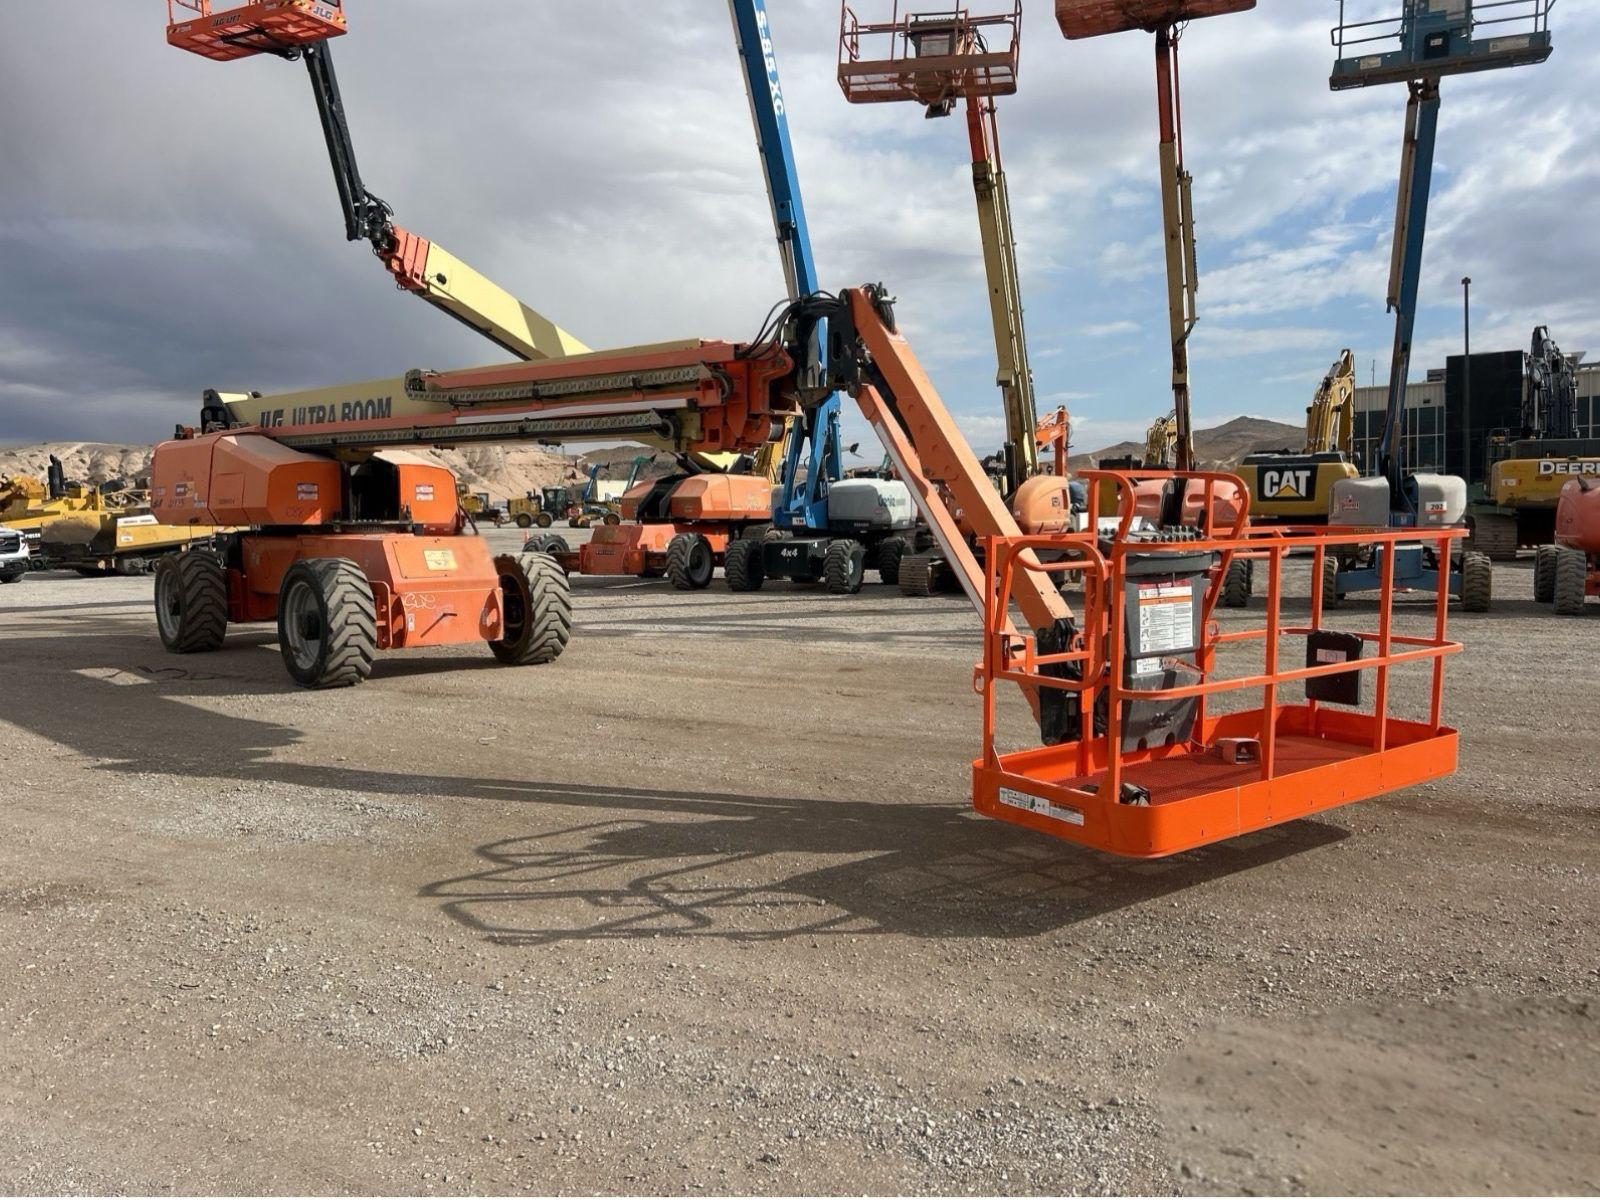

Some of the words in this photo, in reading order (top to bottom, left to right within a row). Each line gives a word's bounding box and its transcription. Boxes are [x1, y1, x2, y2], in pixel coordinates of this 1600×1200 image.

[313, 6, 334, 20] JLG
[755, 10, 776, 72] S-85
[769, 80, 784, 116] XC
[341, 397, 392, 422] BOOM
[1264, 470, 1311, 498] CAT
[780, 547, 798, 558] 4x4
